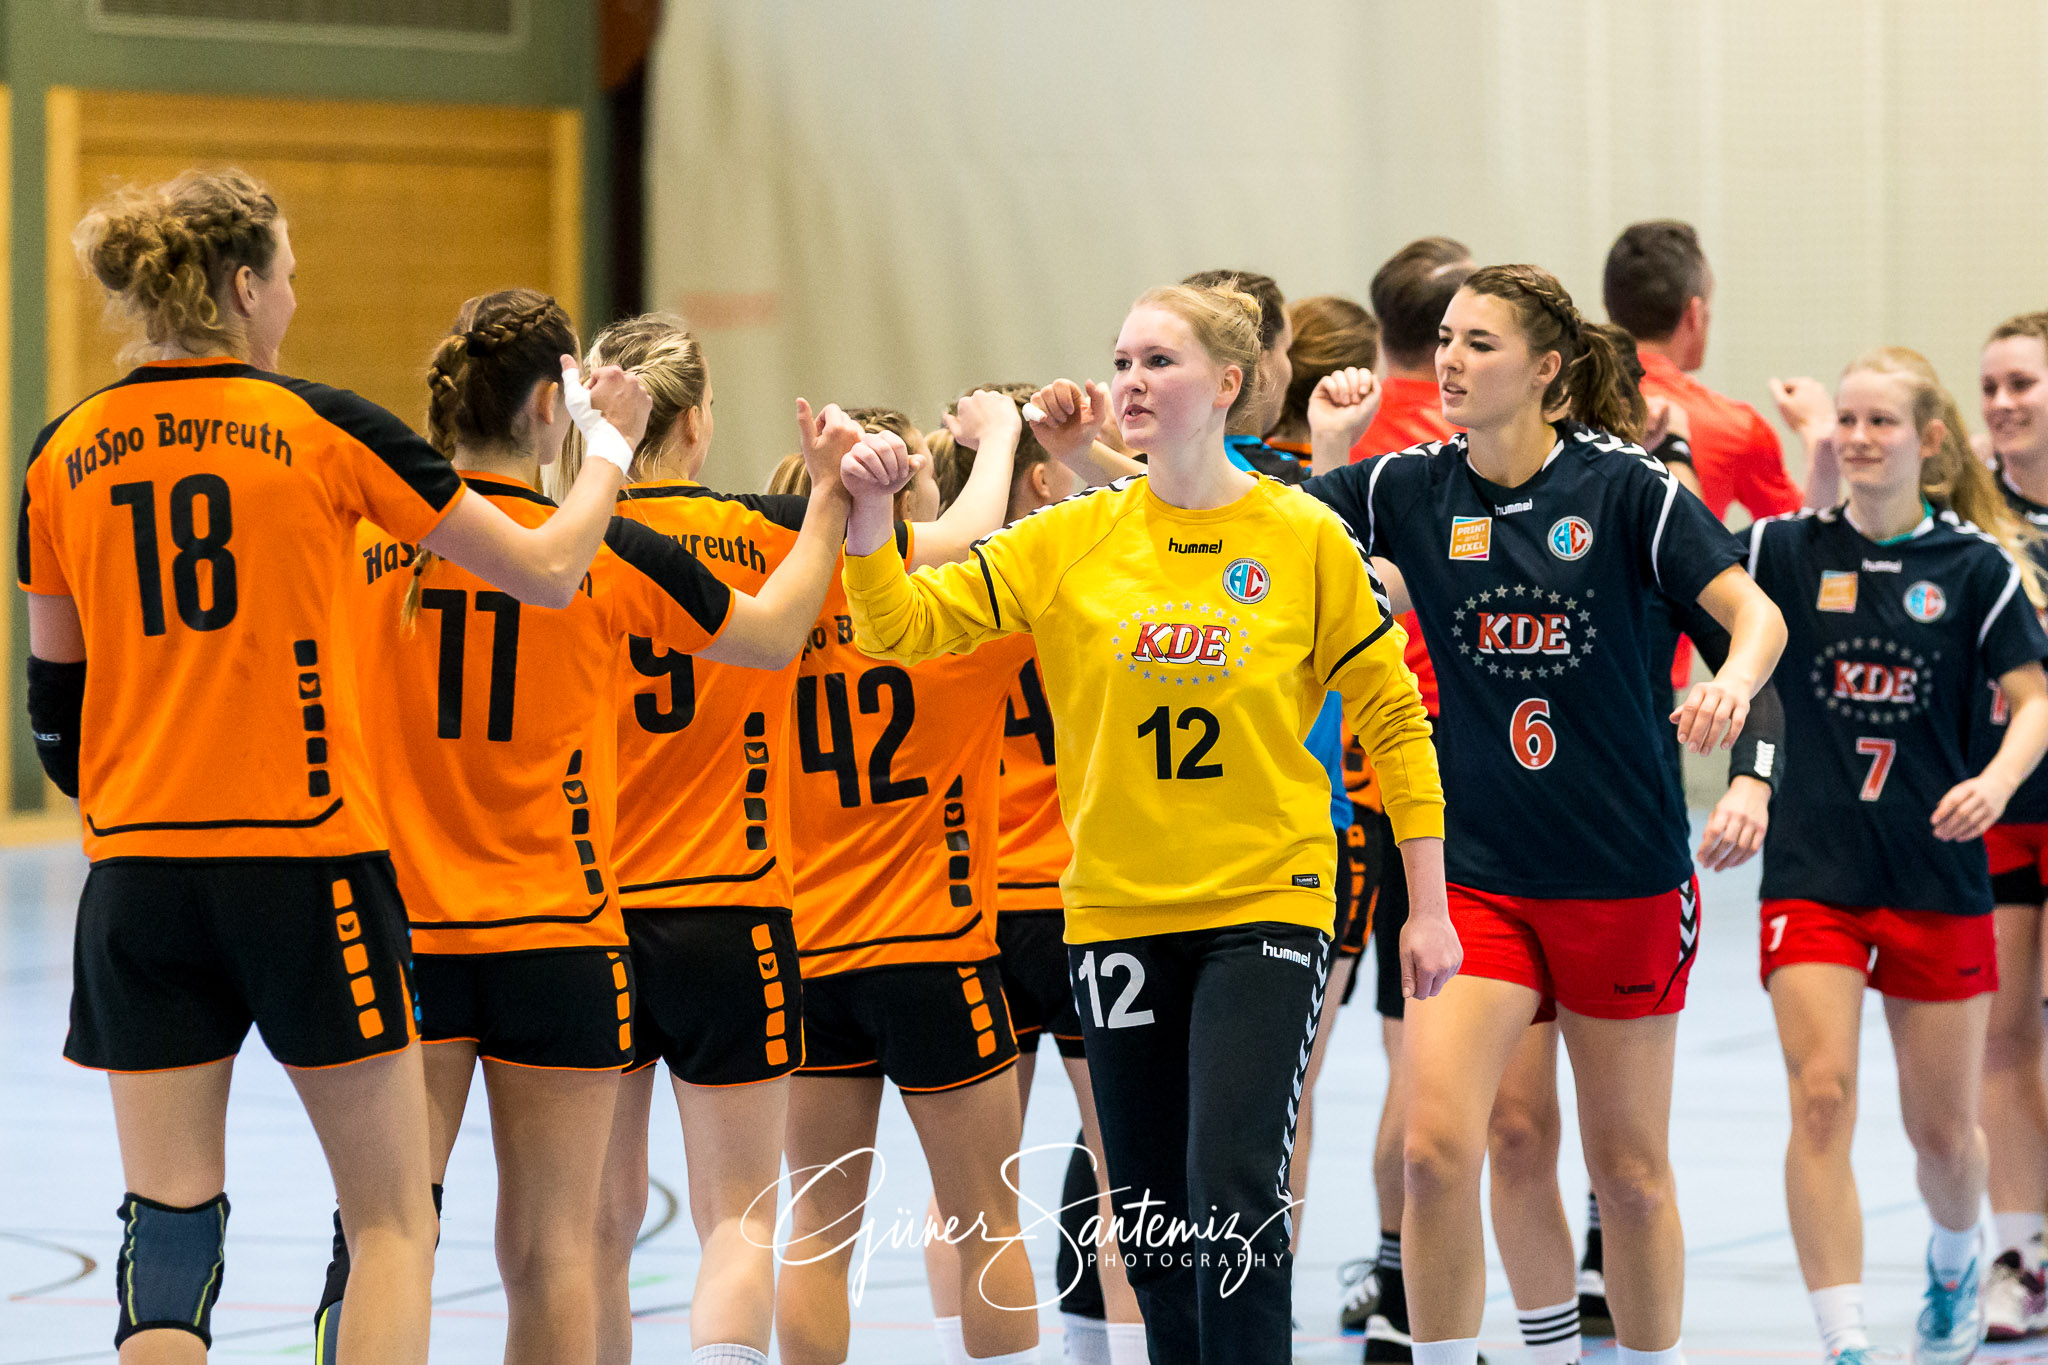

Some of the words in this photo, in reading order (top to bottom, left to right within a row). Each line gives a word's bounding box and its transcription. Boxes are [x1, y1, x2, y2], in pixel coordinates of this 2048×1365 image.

[65, 427, 144, 490] HaSpo
[154, 413, 292, 468] Bayreuth
[1493, 498, 1533, 516] hummel
[1168, 538, 1223, 554] hummel
[1455, 541, 1485, 553] PIXEL
[1456, 523, 1487, 536] PRINT
[111, 473, 240, 637] 18
[363, 541, 423, 585] HaS
[666, 534, 766, 575] yreuth
[1132, 622, 1231, 666] KDE
[1477, 612, 1571, 655] KDE
[421, 588, 520, 742] 11
[1834, 659, 1918, 704] KDE
[797, 666, 929, 808] 42
[1137, 706, 1224, 780] 12
[1510, 697, 1557, 770] 6
[1856, 736, 1896, 802] 7
[1262, 941, 1311, 968] hummel
[1078, 951, 1155, 1029] 12
